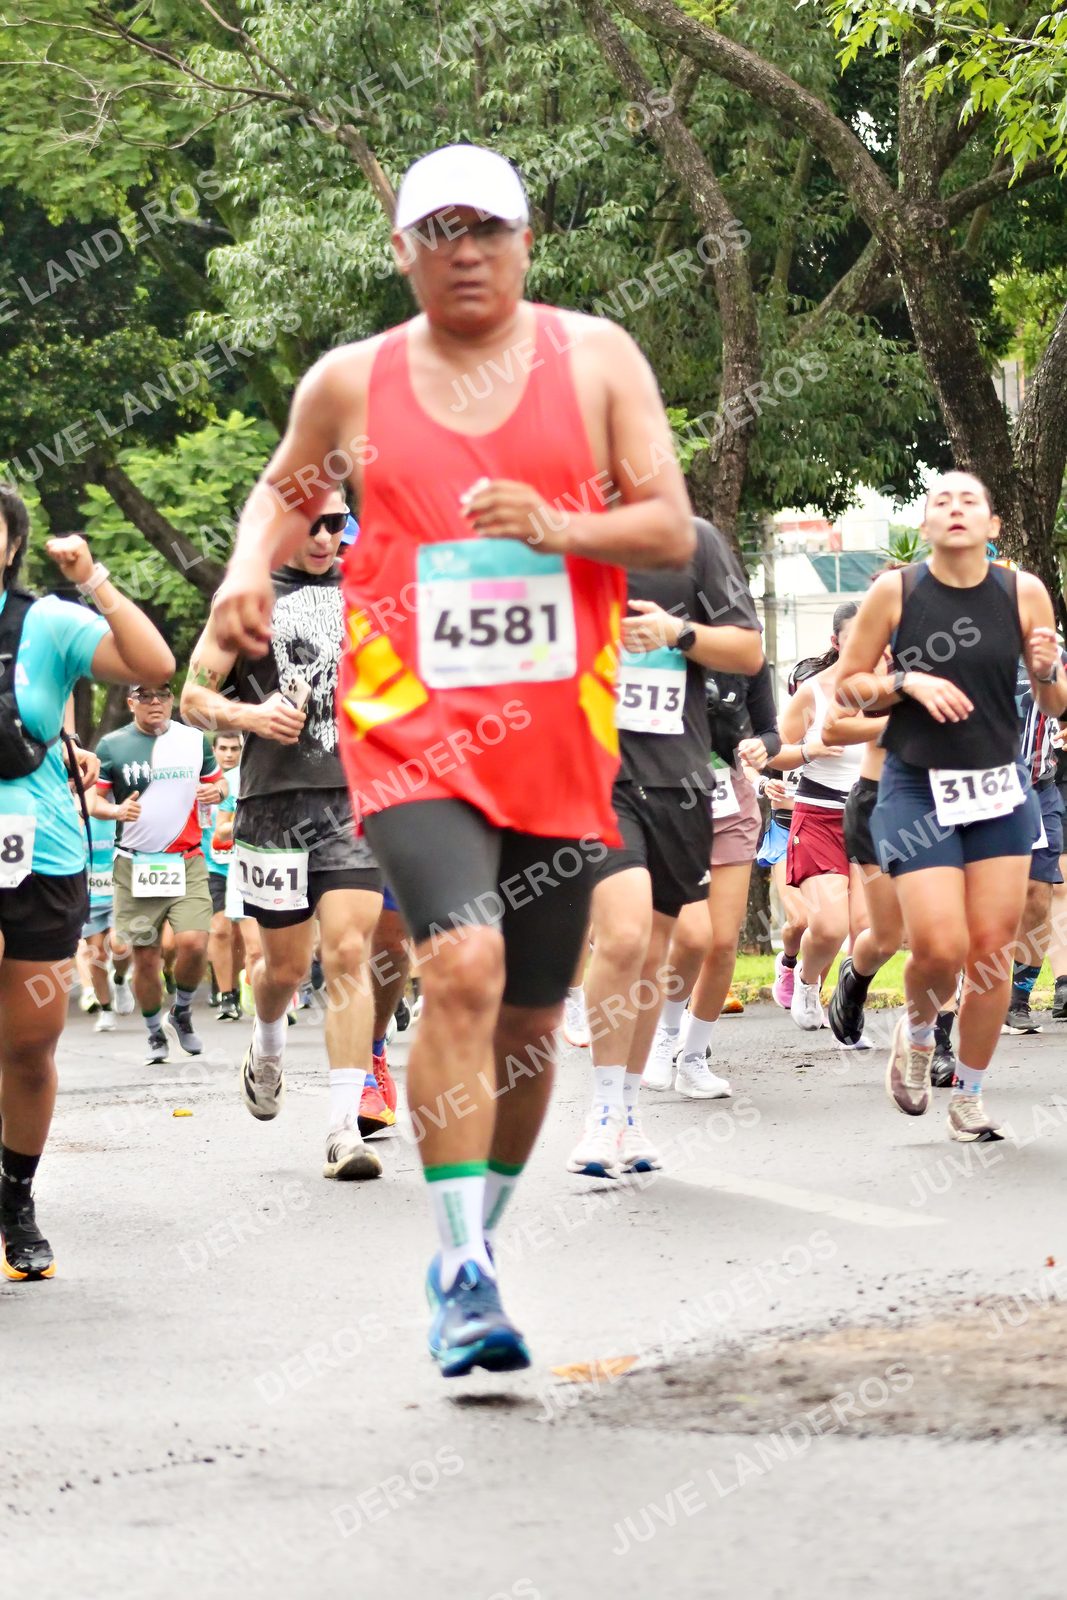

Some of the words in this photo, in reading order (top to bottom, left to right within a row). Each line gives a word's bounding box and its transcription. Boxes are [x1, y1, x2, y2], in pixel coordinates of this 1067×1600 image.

[433, 604, 557, 648] 4581
[616, 683, 680, 712] 513
[153, 770, 194, 780] NAYARIT
[787, 771, 804, 785] 4
[940, 768, 1013, 803] 3162
[711, 780, 728, 801] 5
[138, 872, 181, 885] 4022
[239, 860, 298, 891] 1041
